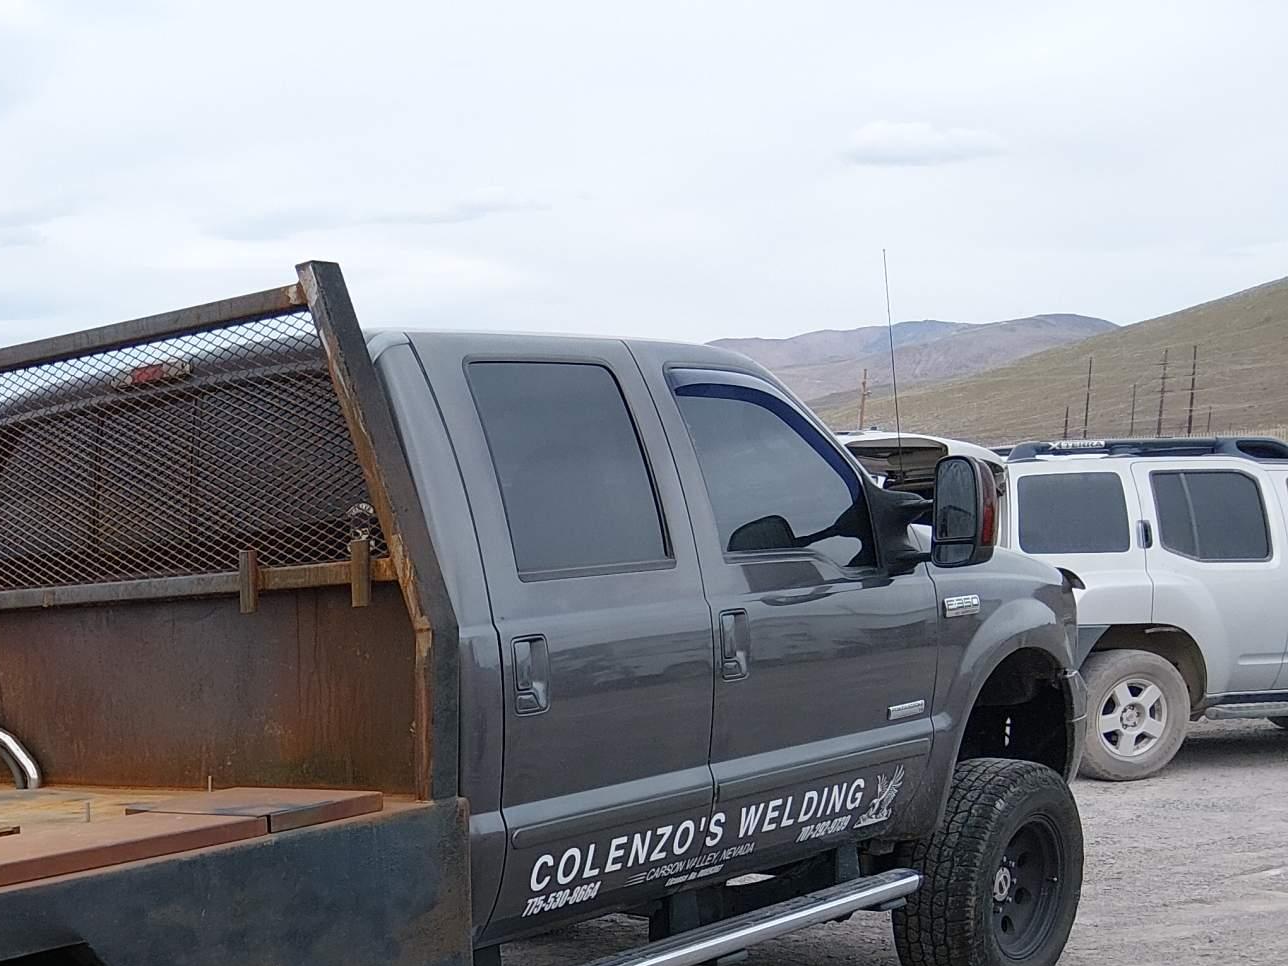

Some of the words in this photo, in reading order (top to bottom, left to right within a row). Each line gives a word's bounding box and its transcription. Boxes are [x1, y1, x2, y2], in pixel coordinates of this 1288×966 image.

[529, 811, 726, 891] COLENZO'S
[738, 778, 865, 838] WELDING
[646, 860, 686, 880] CARSON
[719, 842, 755, 861] NEVADA
[521, 880, 602, 917] 775-530-8664
